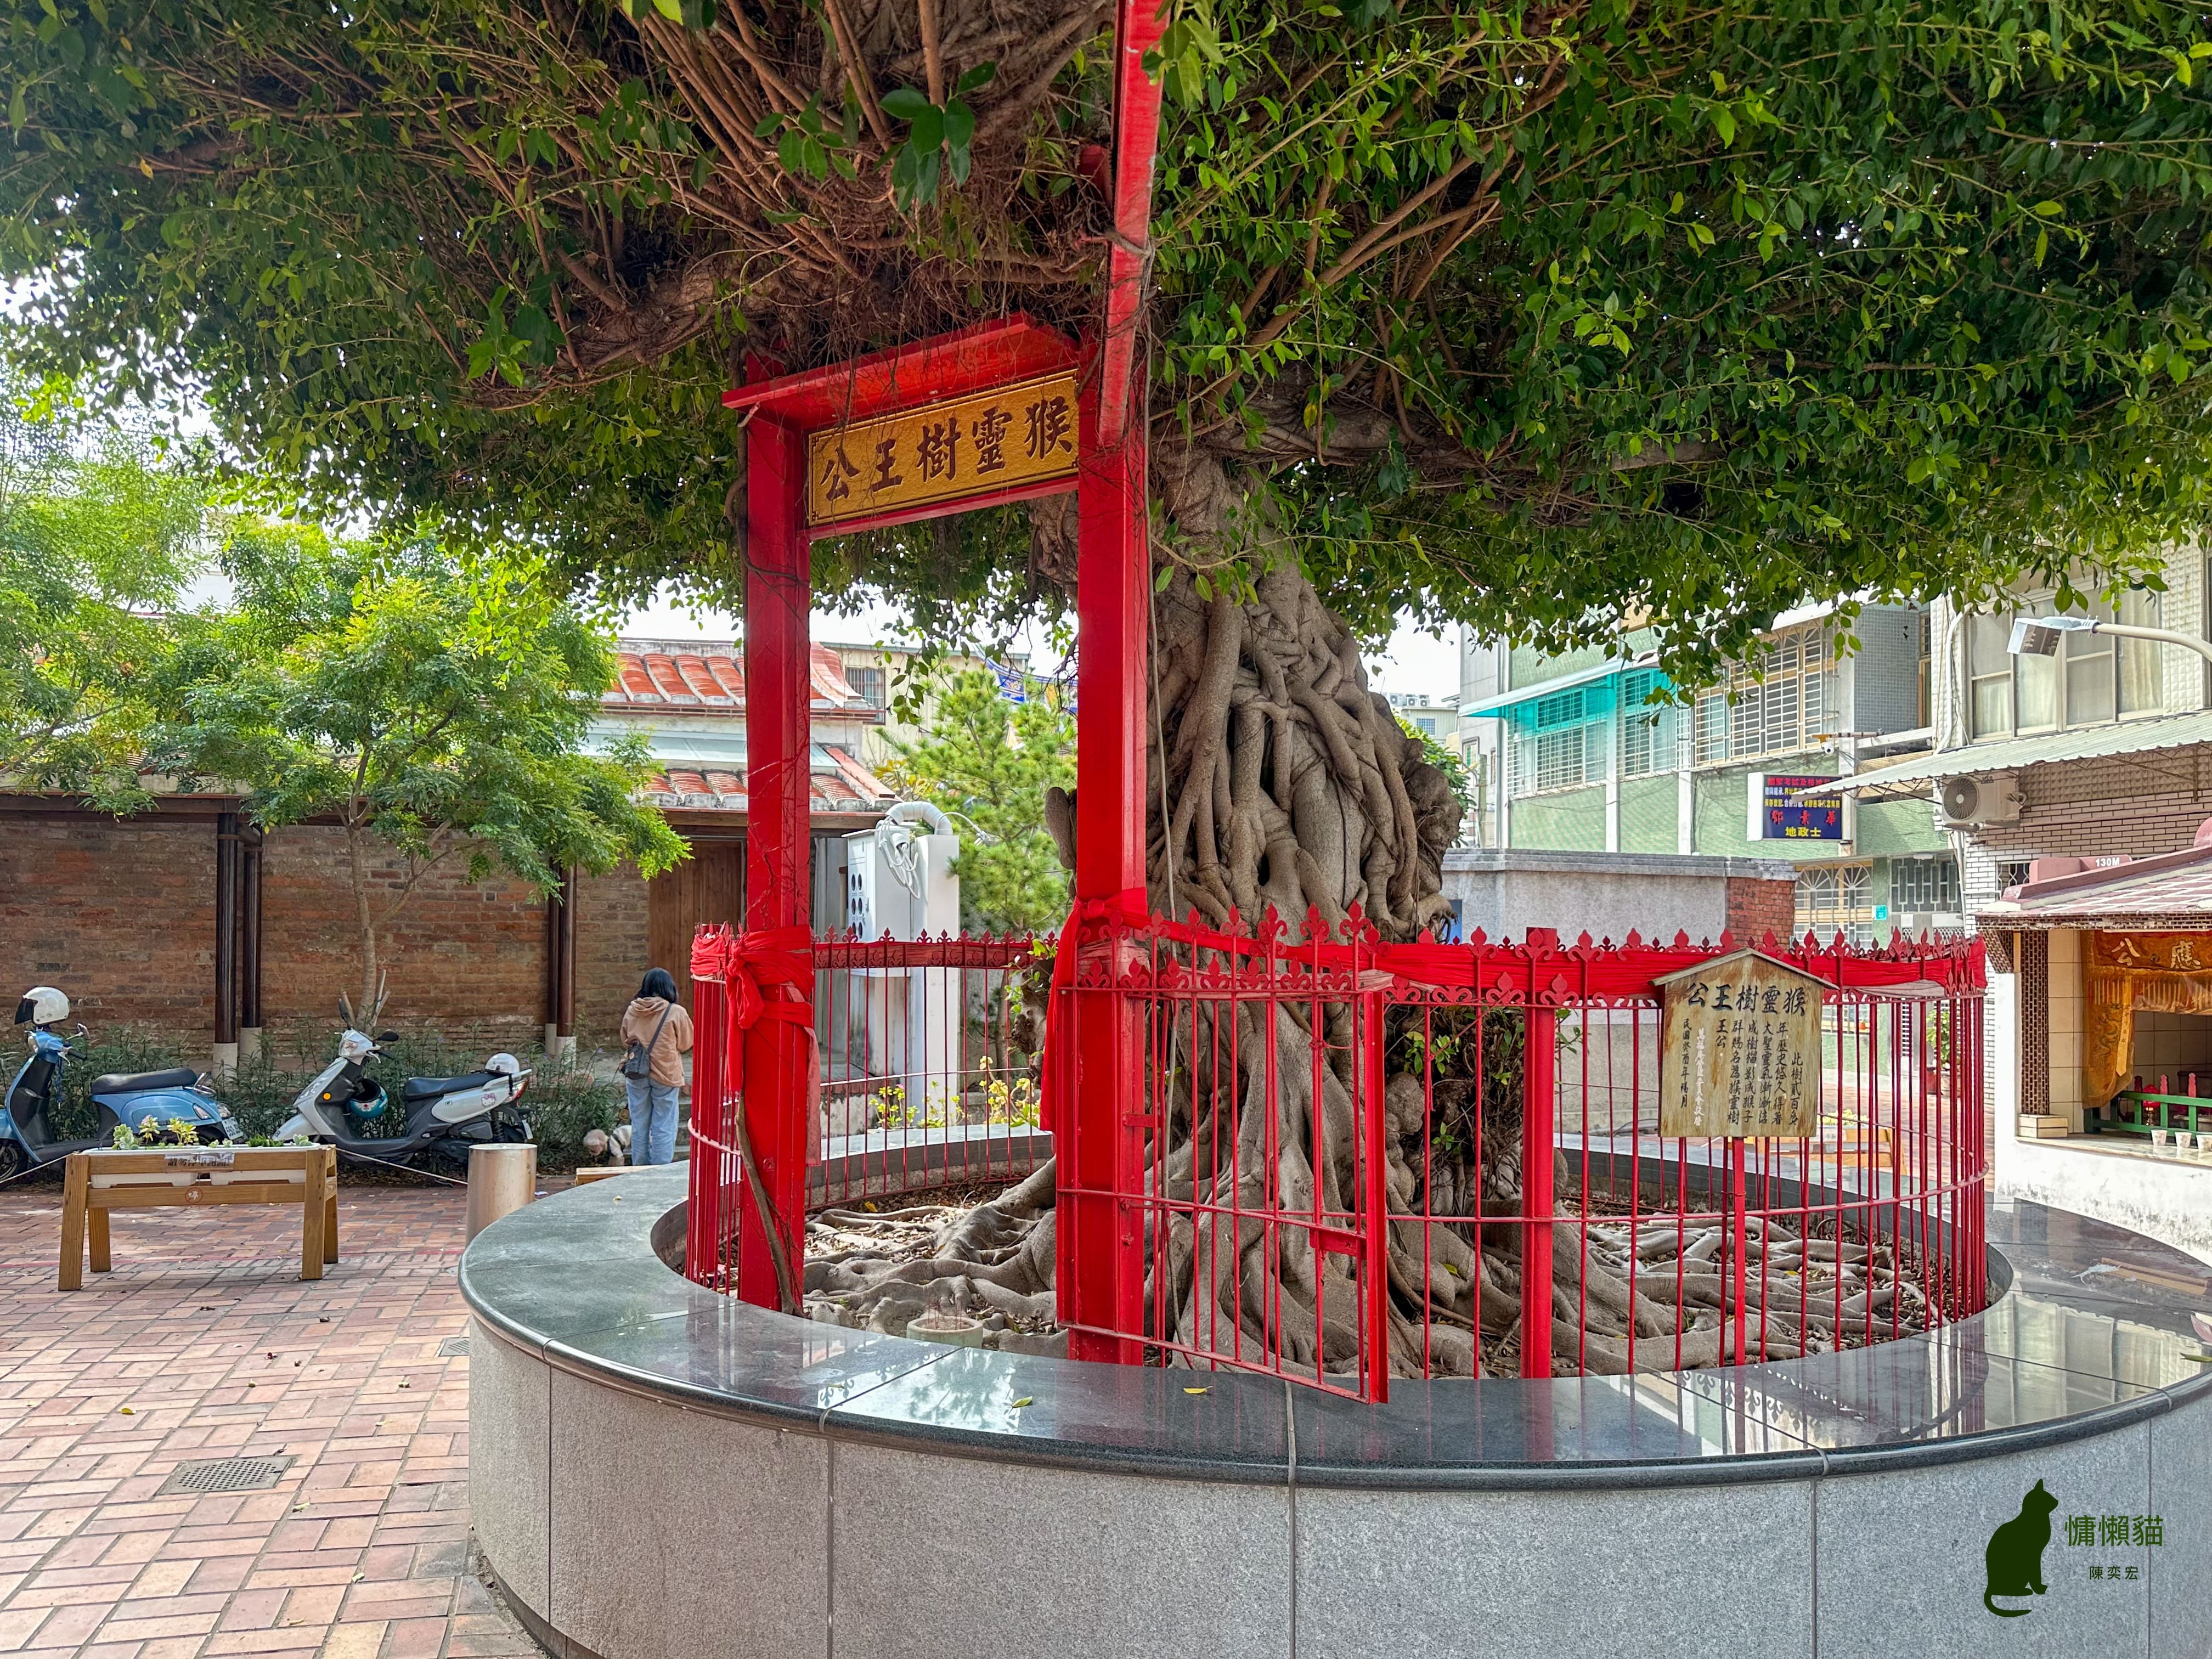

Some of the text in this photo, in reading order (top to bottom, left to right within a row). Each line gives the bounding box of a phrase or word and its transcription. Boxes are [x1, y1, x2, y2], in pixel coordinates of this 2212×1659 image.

[1785, 826, 1821, 837] 地政士
[2095, 857, 2120, 867] 130M
[1716, 1018, 1728, 1048] 王公
